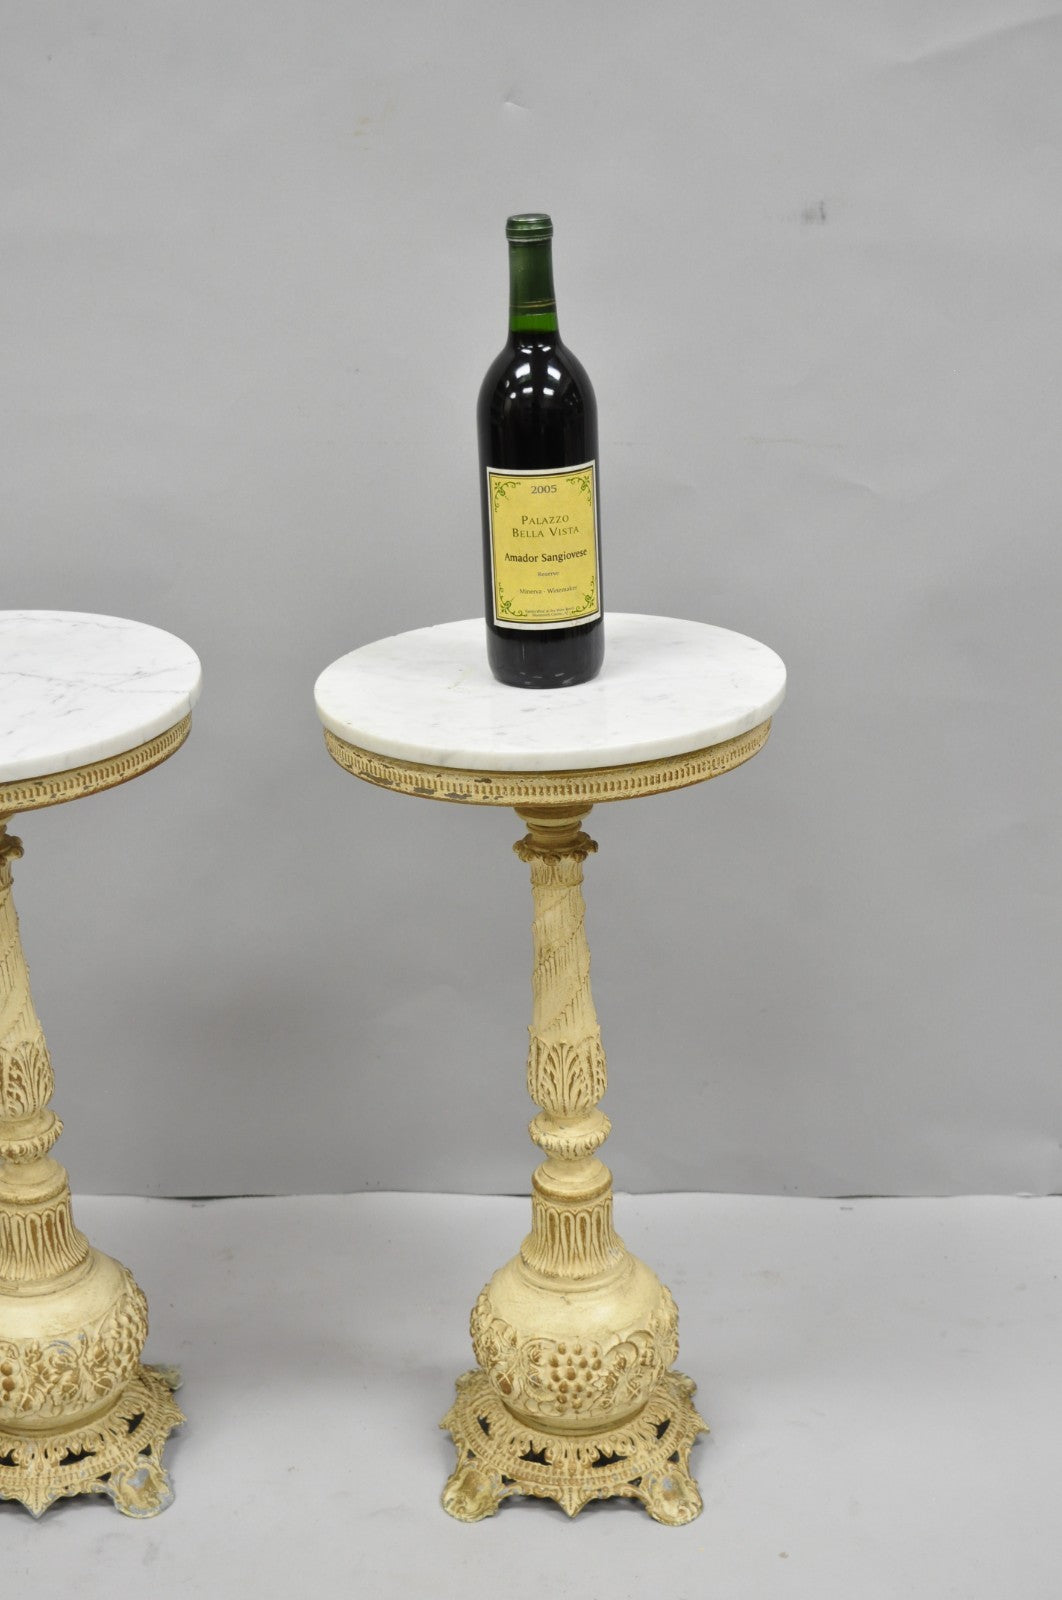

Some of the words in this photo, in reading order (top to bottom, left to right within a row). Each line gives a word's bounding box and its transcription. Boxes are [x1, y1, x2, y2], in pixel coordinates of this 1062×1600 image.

[530, 485, 557, 494] 2005
[521, 515, 570, 525] PALAZZO
[512, 528, 545, 538] BELLA
[549, 526, 580, 537] VISTA
[504, 552, 539, 563] Amador
[541, 548, 588, 563] Sangiovese
